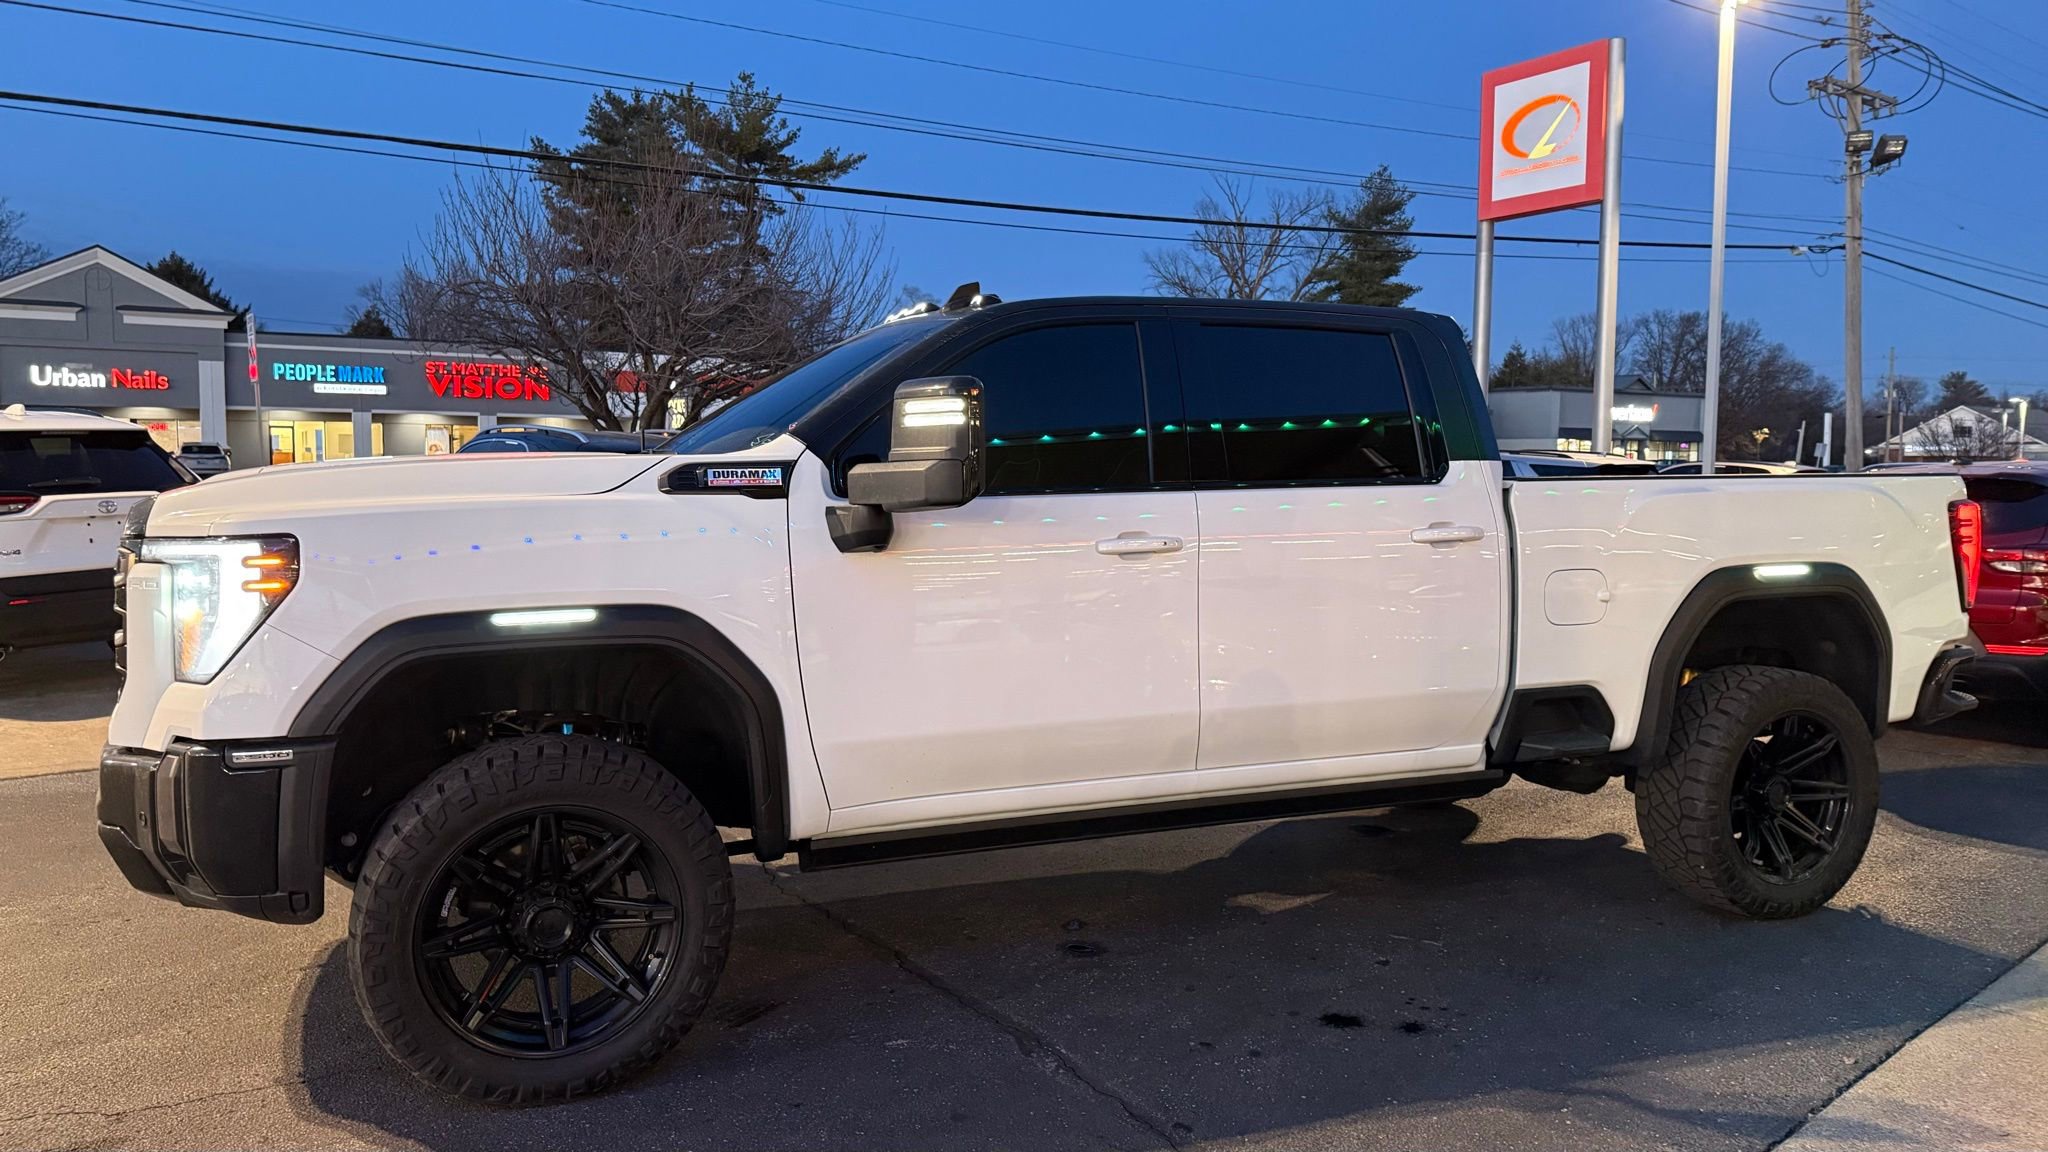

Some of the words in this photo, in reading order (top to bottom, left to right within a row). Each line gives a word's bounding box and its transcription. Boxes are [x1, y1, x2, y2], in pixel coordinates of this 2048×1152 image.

[30, 364, 106, 388] Urban
[111, 367, 169, 390] Nails
[425, 361, 448, 374] ST.
[426, 374, 550, 401] VISION
[712, 469, 777, 479] DURAMAX
